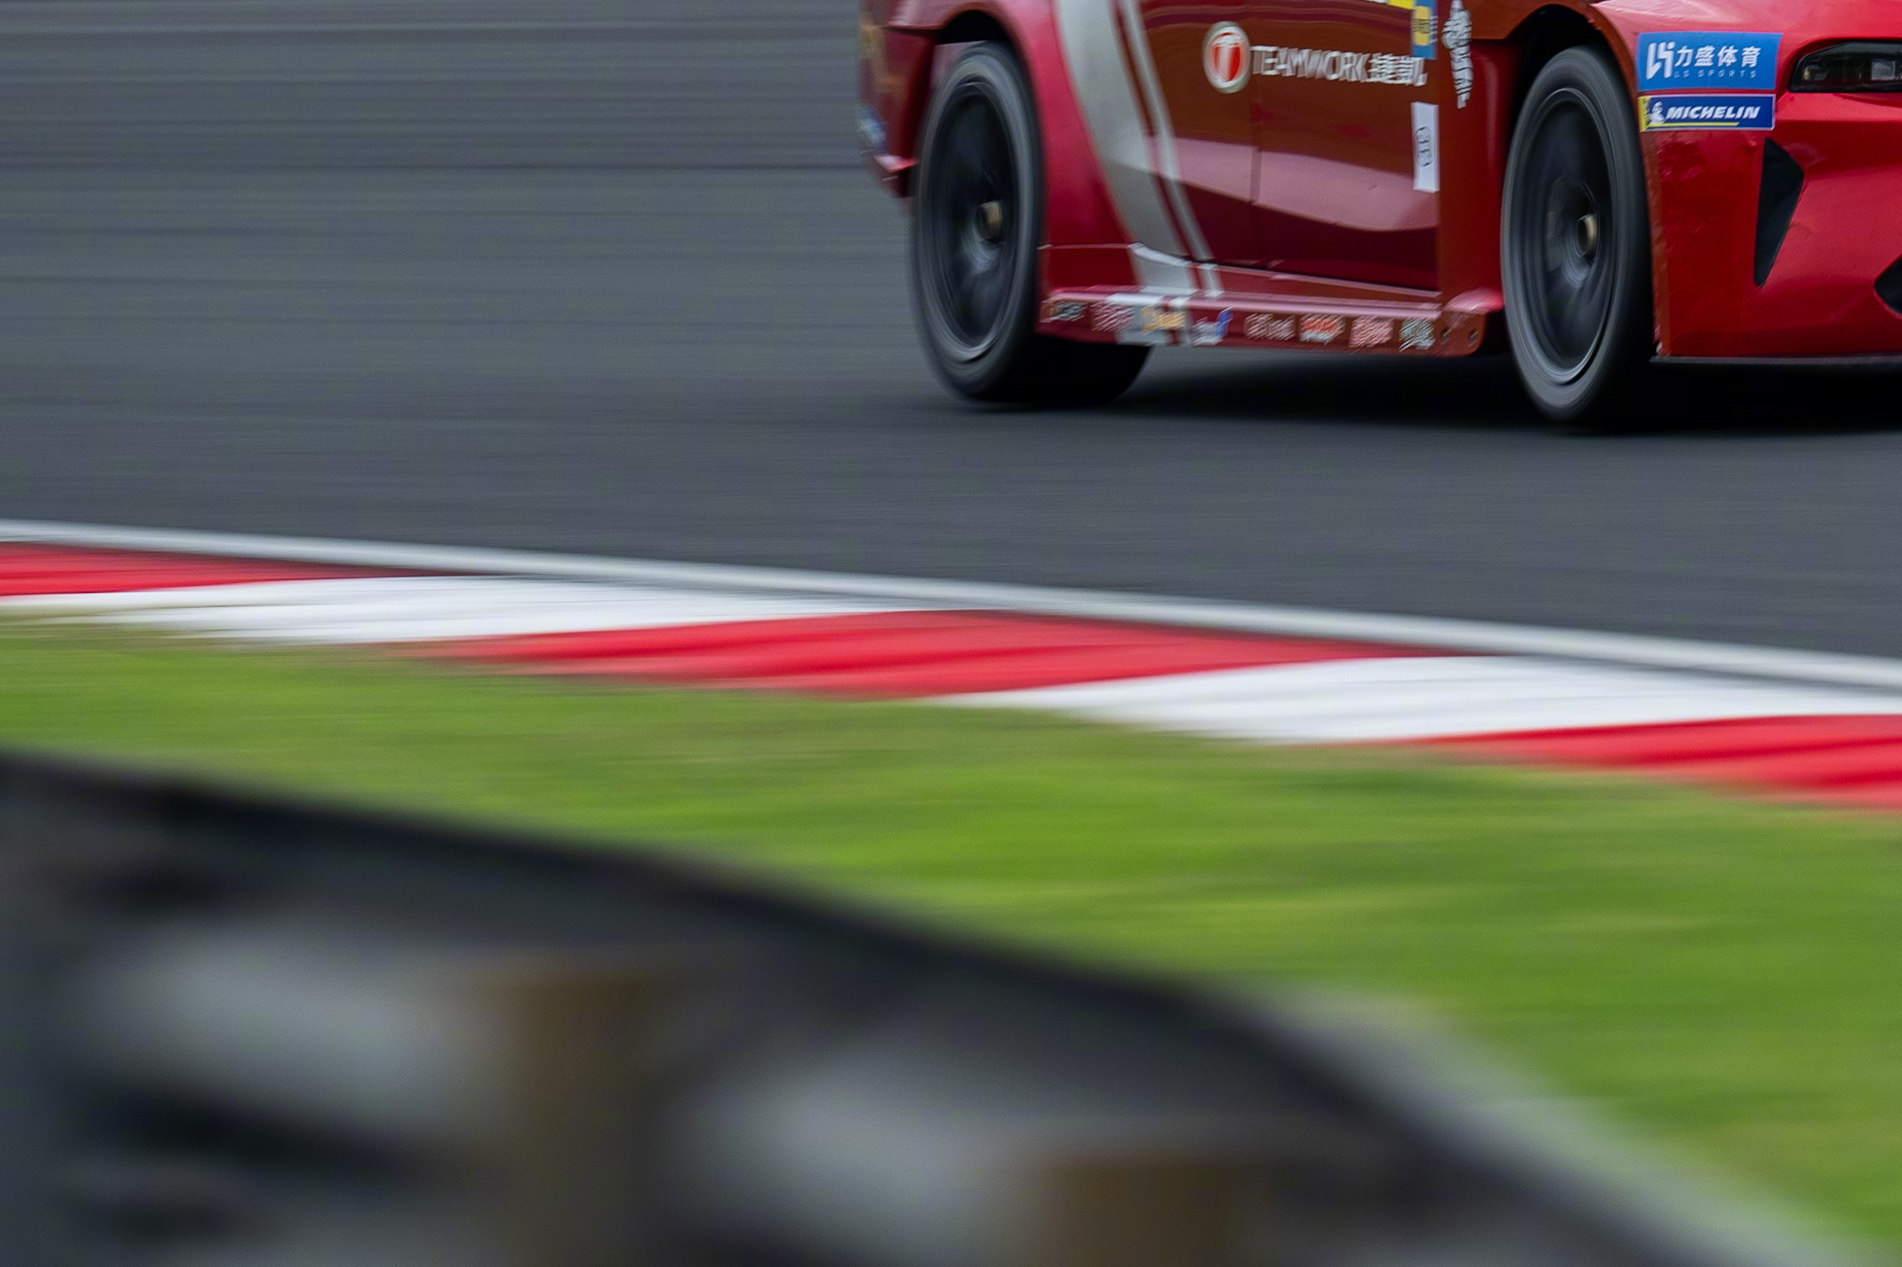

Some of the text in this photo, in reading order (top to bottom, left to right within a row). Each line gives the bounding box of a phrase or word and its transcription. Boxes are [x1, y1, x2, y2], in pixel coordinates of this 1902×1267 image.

[1674, 45, 1761, 68] 力盛体育
[1665, 106, 1760, 120] MICHELIN
